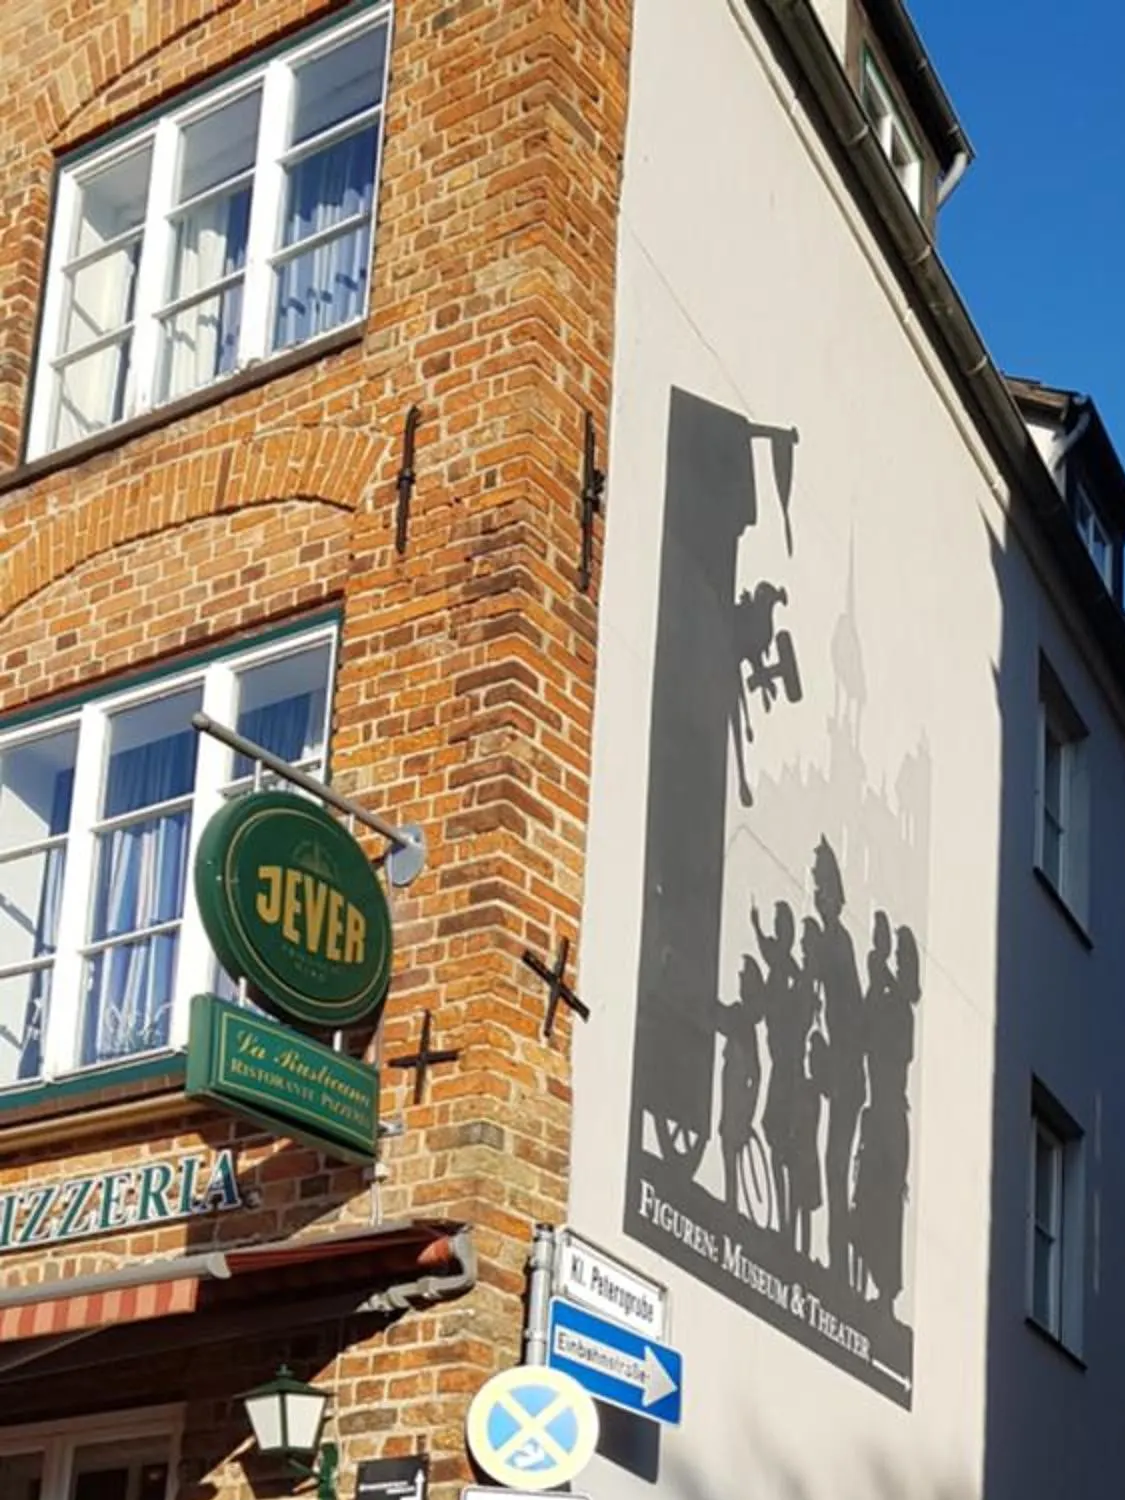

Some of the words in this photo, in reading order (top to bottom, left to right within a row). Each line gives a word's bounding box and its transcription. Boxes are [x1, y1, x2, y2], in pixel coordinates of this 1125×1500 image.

[256, 865, 366, 964] JEVER
[721, 1235, 789, 1310] MUSEUM
[790, 1283, 806, 1319] &
[806, 1292, 870, 1361] THEATER
